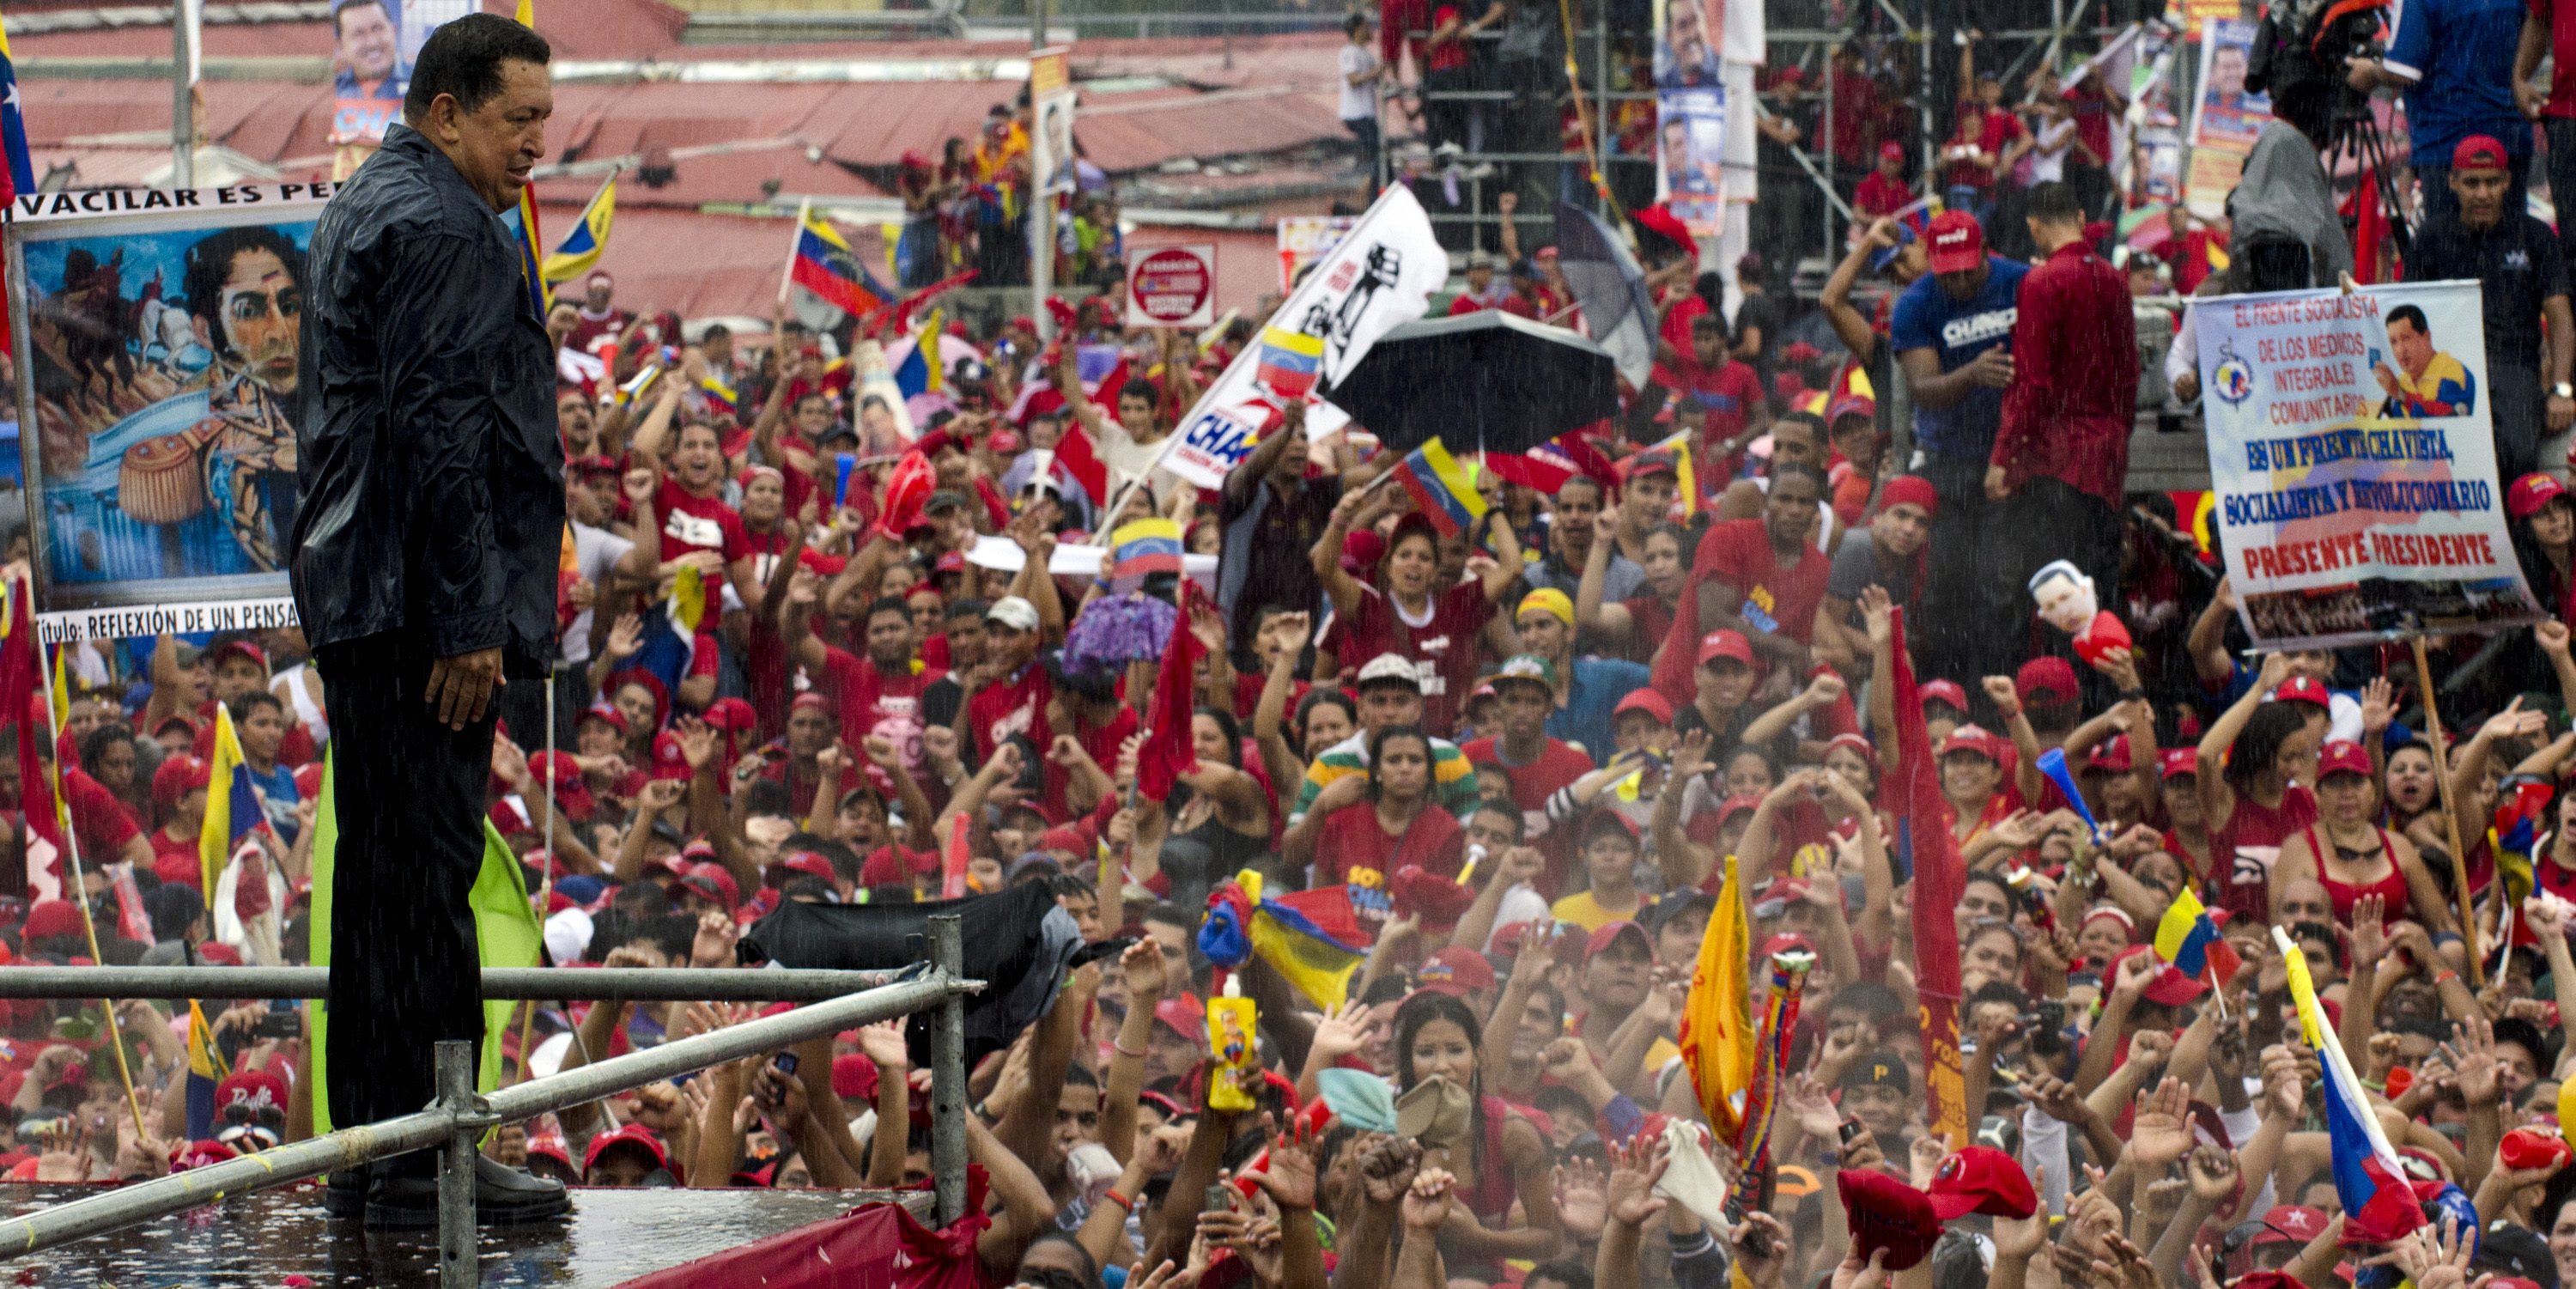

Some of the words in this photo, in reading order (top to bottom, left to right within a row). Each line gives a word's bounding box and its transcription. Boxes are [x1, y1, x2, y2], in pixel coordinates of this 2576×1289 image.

[218, 185, 263, 204] ES
[280, 182, 344, 201] PE
[2234, 304, 2251, 329] EL
[2253, 300, 2302, 326] FRENTE
[2305, 294, 2379, 323] SOCIALISTA
[2258, 337, 2276, 363] DE
[2278, 336, 2306, 362] LOS
[2307, 329, 2366, 359] MÉDICOS
[2245, 439, 2269, 471] ES
[2268, 434, 2298, 471] UN
[2295, 429, 2369, 465] FRENTE
[2224, 483, 2337, 526] SOCIALISTA
[2332, 478, 2351, 511] Y
[2242, 530, 2371, 581] PRESENTE
[2369, 531, 2497, 567] PRESIDENTE
[36, 616, 83, 643] ítulo:
[88, 603, 178, 639] REFLEXIÓN
[185, 608, 205, 631] DE
[211, 605, 236, 629] UN
[1873, 1063, 1890, 1083] P
